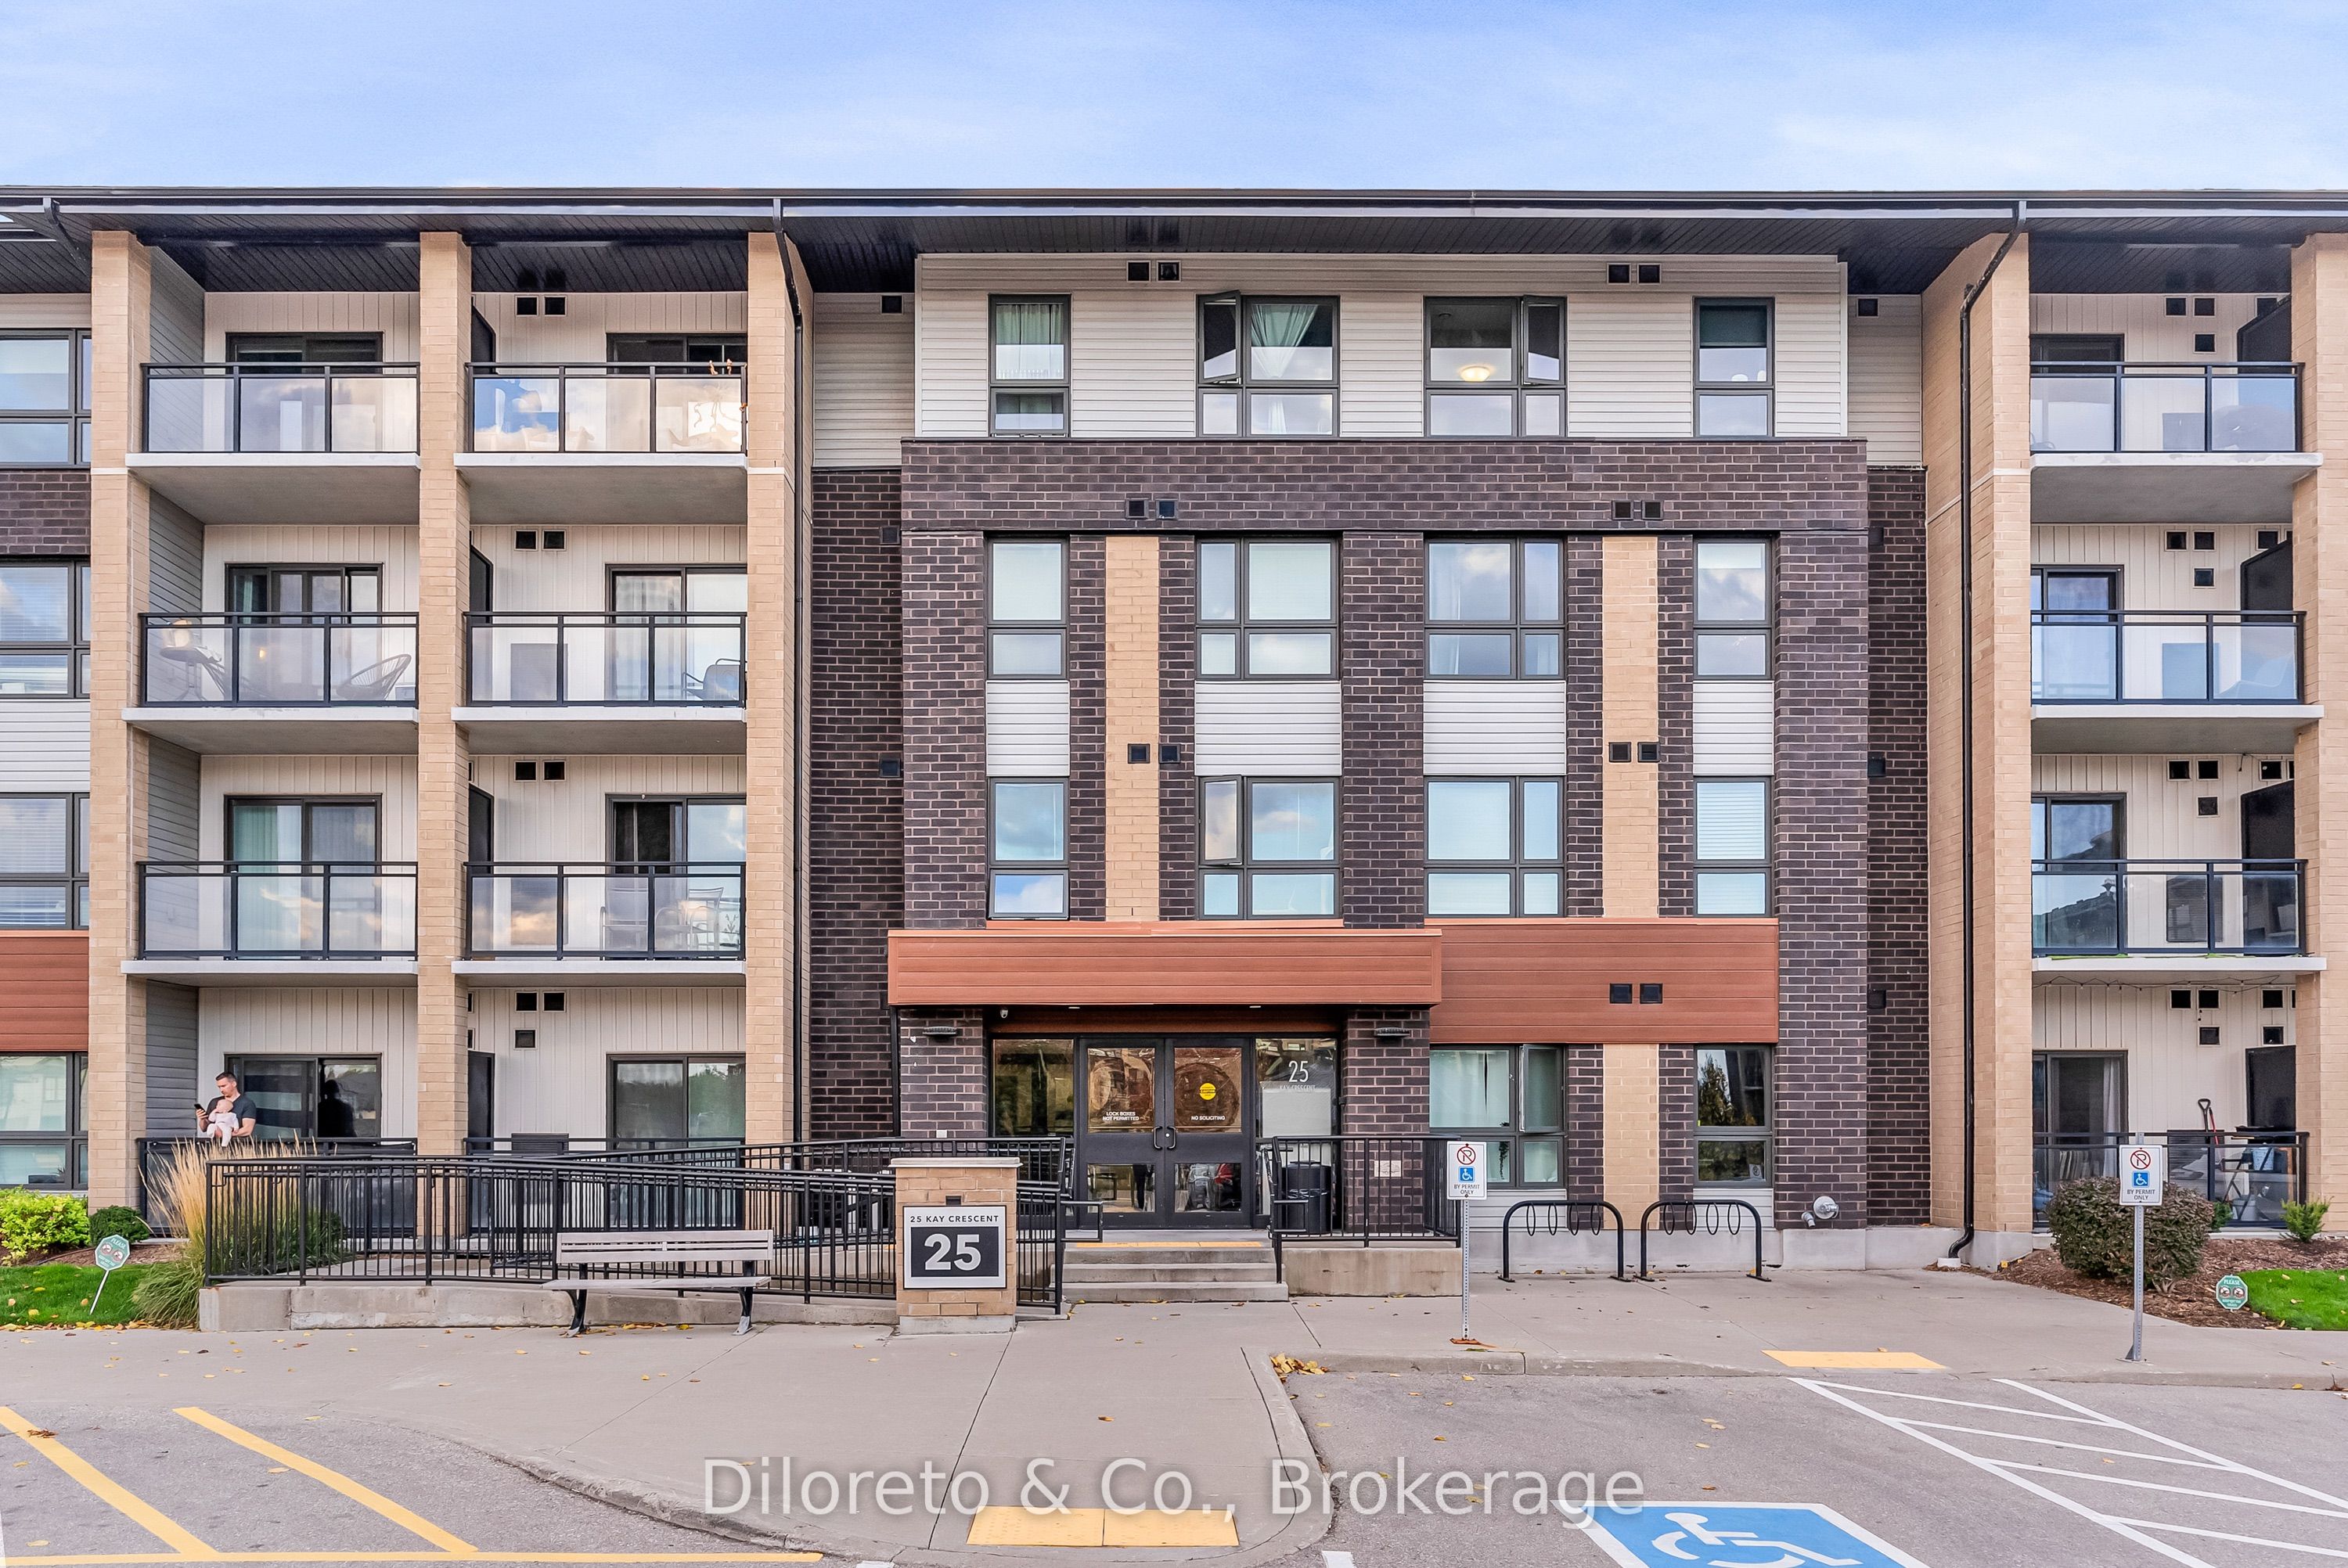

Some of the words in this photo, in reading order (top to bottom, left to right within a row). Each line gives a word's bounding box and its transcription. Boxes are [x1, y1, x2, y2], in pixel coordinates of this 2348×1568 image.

[1288, 1060, 1309, 1083] 25
[110, 1238, 126, 1250] PLEASE
[924, 1233, 981, 1271] 25
